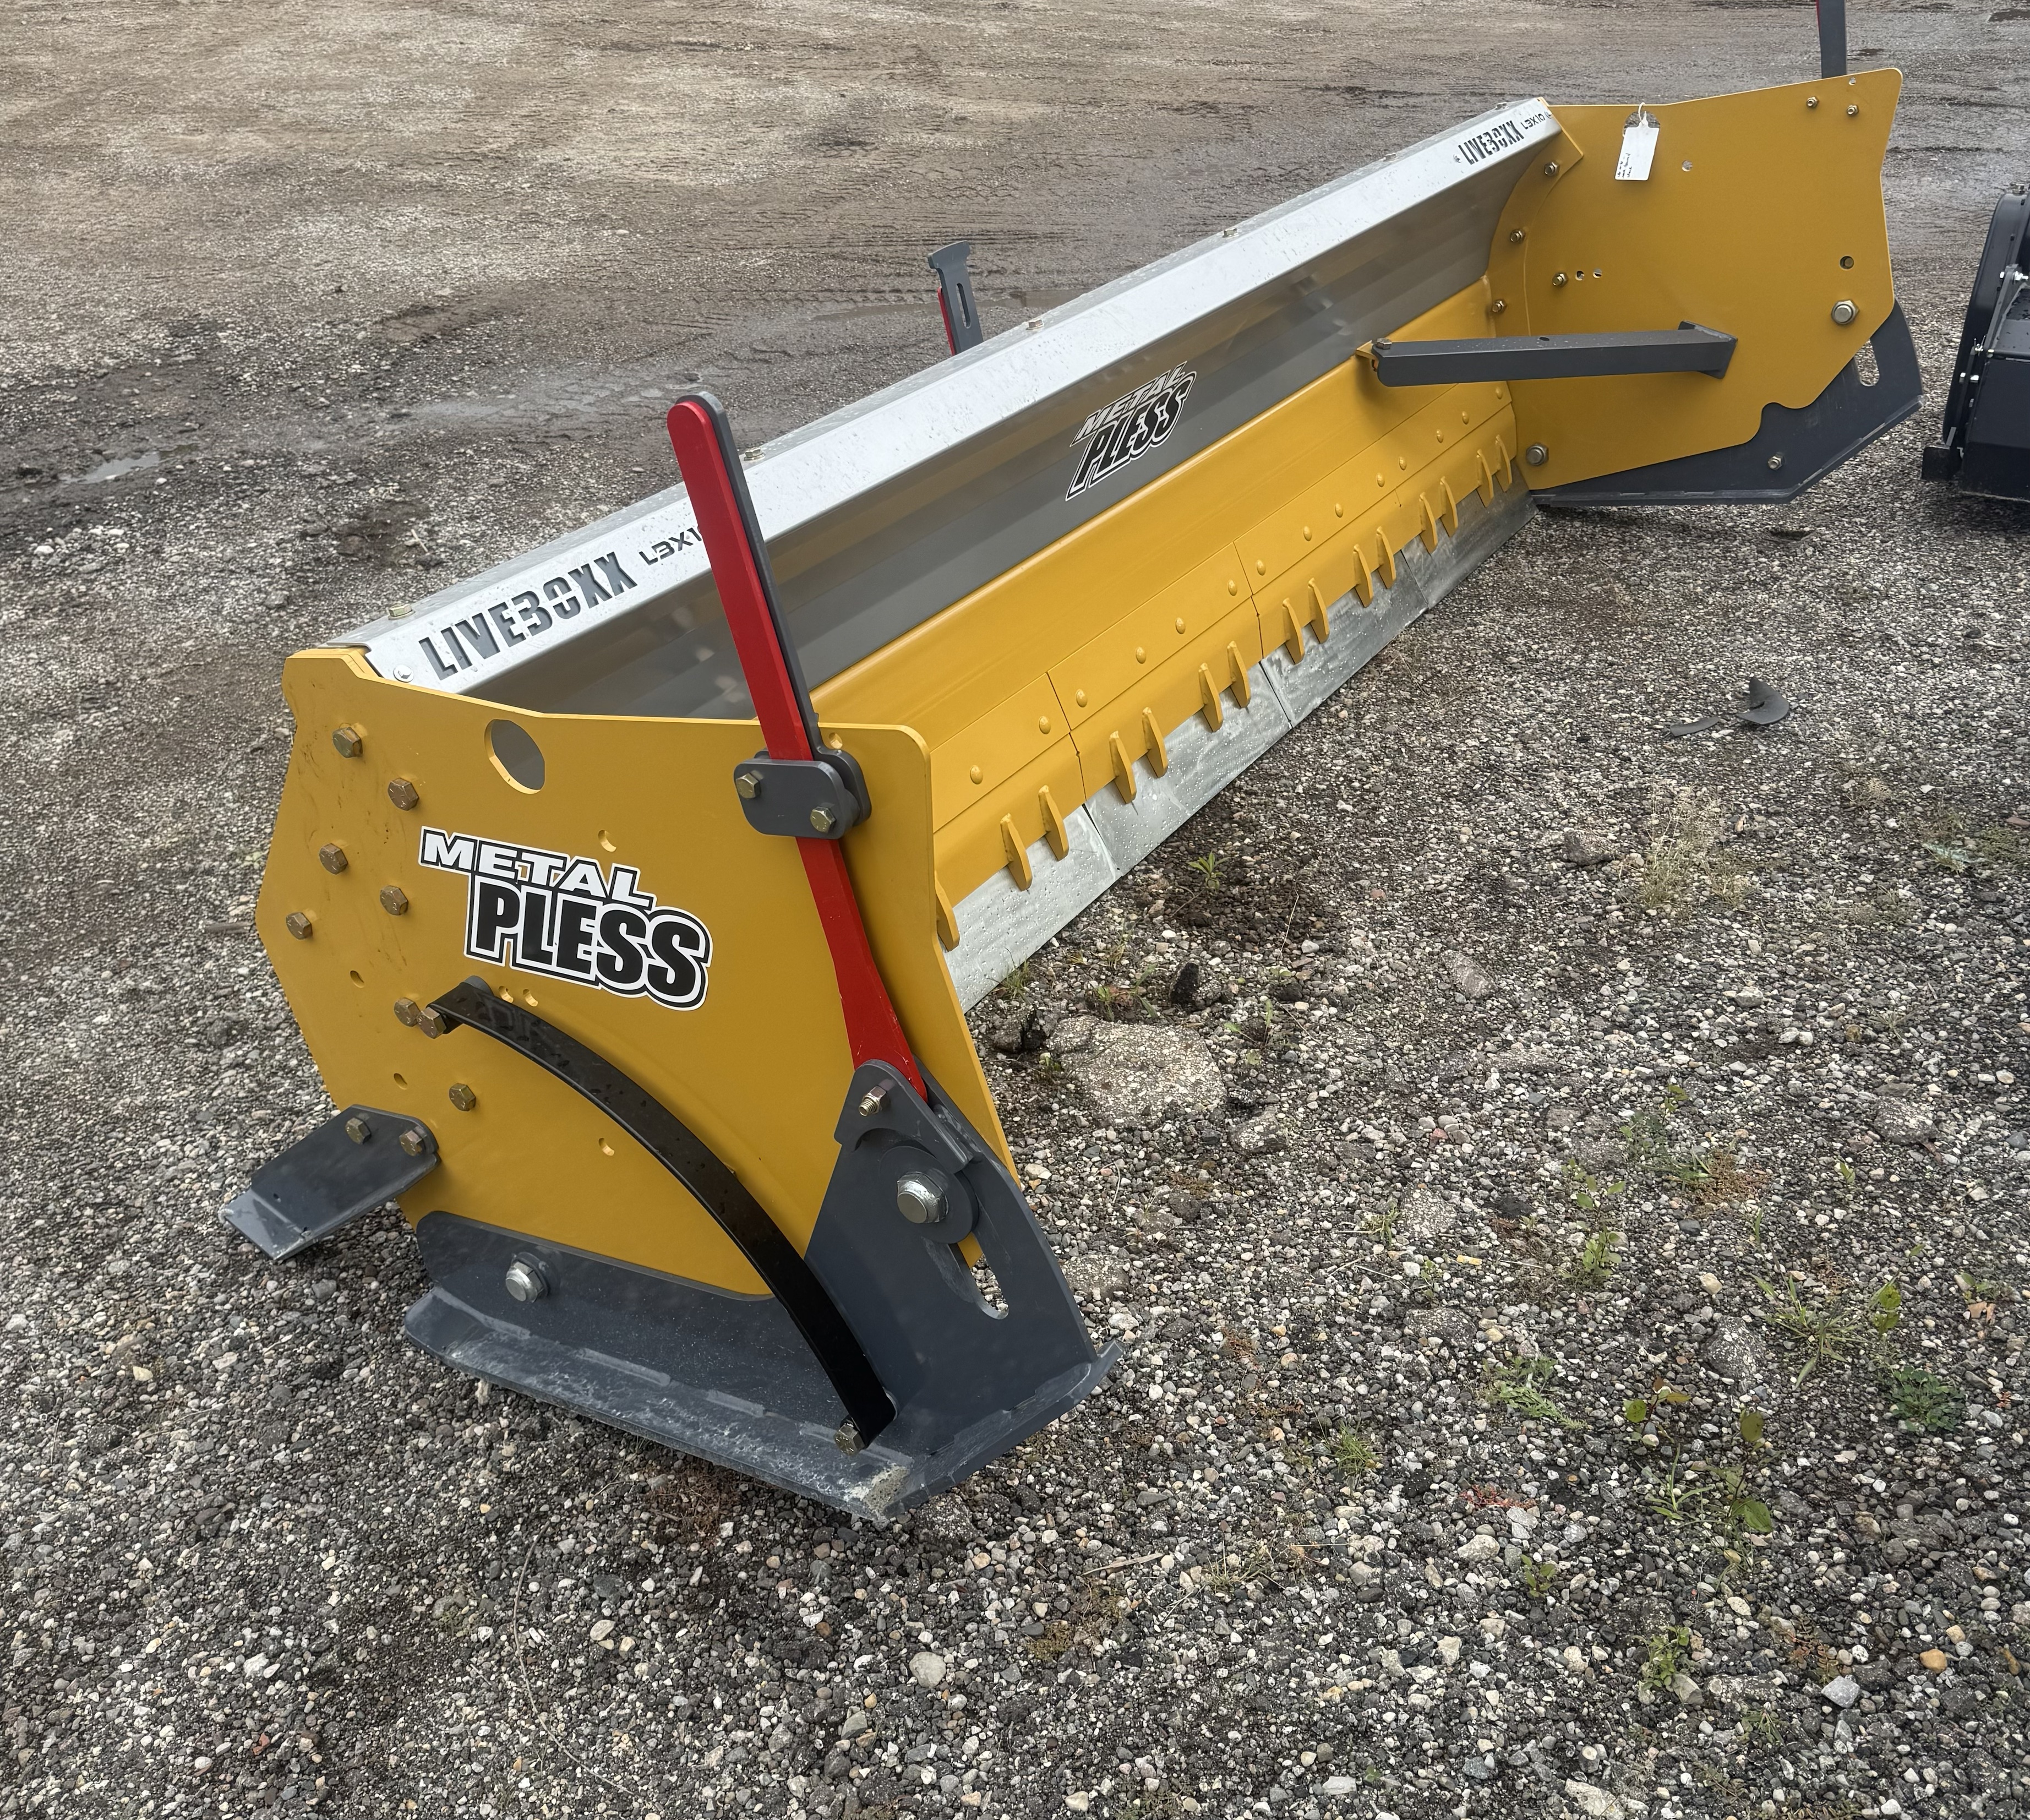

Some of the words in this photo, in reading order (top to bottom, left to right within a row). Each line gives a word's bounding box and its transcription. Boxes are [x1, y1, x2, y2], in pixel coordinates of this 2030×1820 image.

[1068, 373, 1196, 498] PLESS
[1072, 364, 1186, 443] METAL
[639, 527, 702, 565] LBX1
[422, 829, 654, 909] METAL
[467, 875, 711, 1007] PLESS
